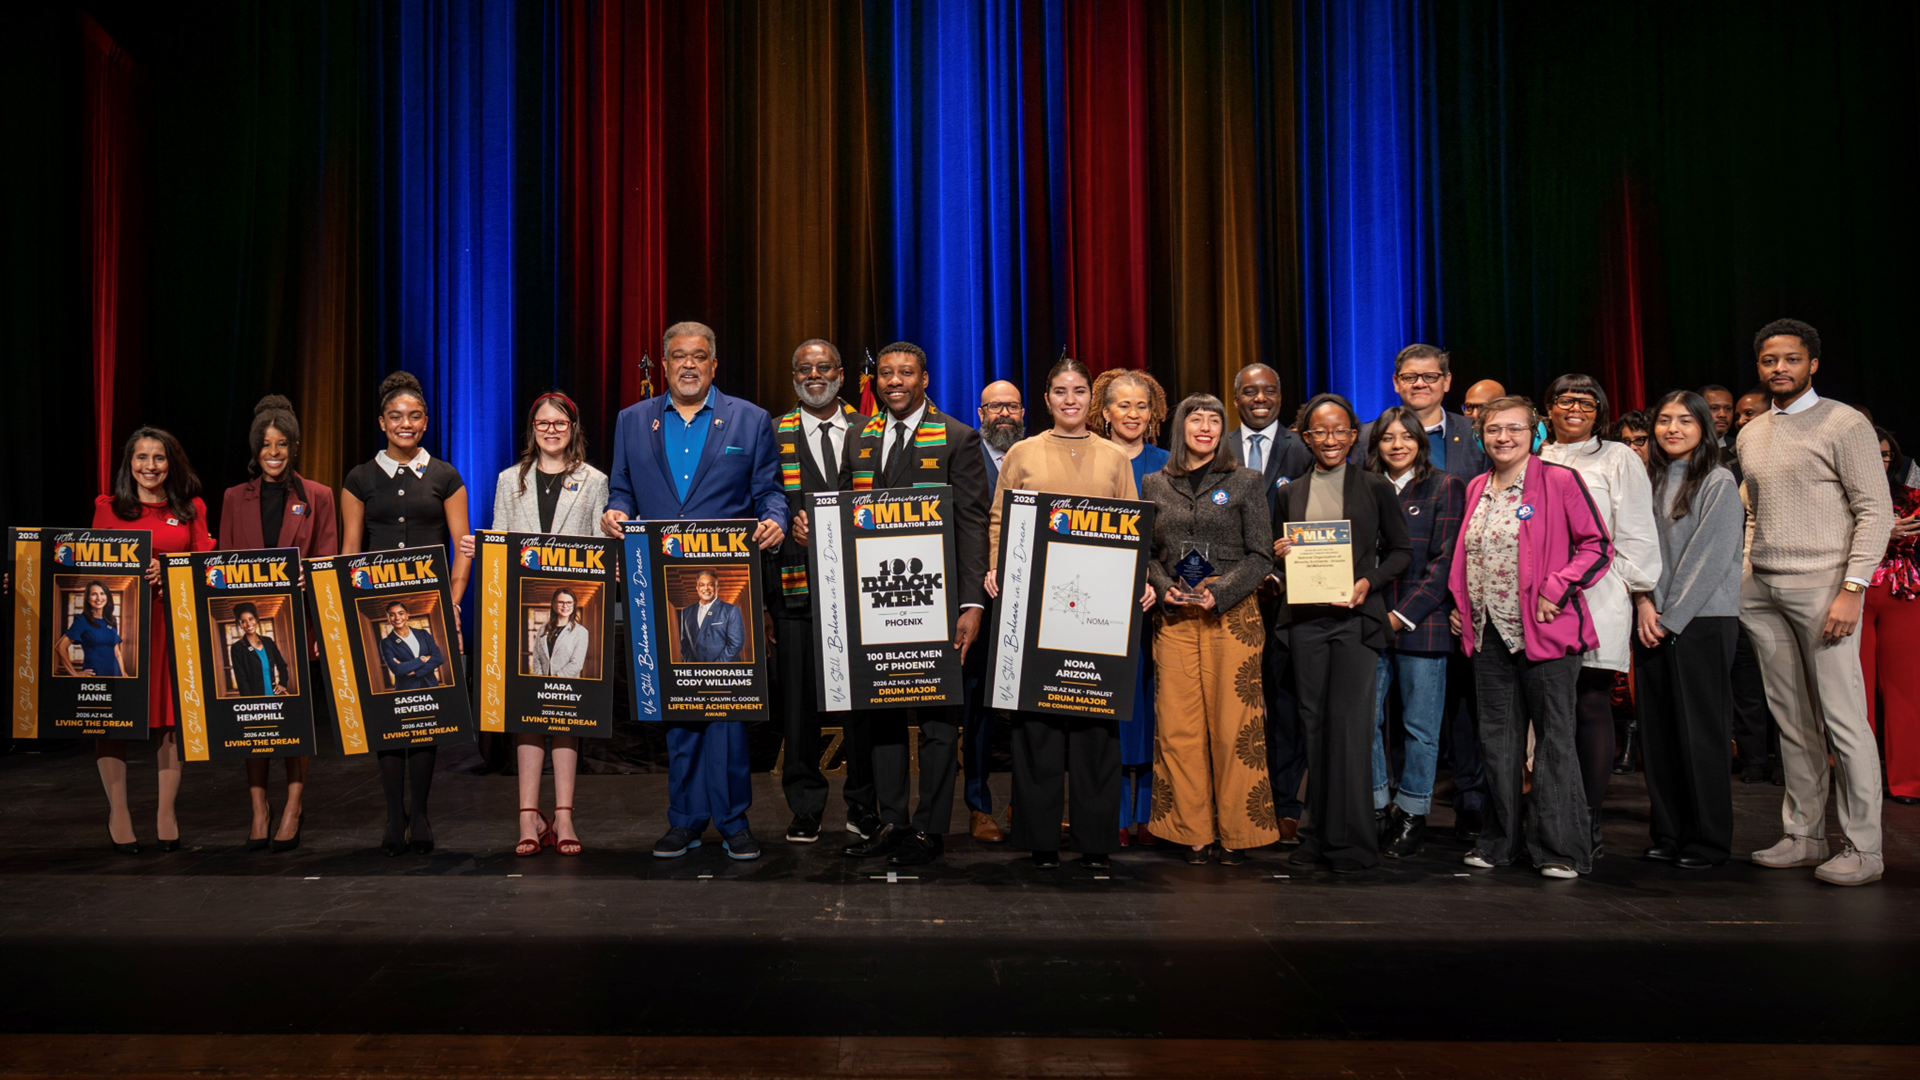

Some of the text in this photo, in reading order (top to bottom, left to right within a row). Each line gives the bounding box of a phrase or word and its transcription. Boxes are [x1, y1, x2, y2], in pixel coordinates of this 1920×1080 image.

[816, 497, 837, 505] 2026
[852, 492, 939, 506] 40th Anniversary
[1014, 495, 1035, 504] 2026
[875, 500, 942, 523] MLK
[1050, 498, 1140, 516] 40th Anniversary
[1071, 509, 1141, 535] MLK
[660, 523, 746, 535] 40th Anniversary
[1071, 530, 1121, 539] CELEBRATION
[1303, 530, 1337, 540] MLK
[54, 532, 139, 544] 40th Anniversary
[520, 537, 604, 551] 40th Anniversary
[683, 533, 749, 552] MLK
[76, 543, 140, 562] MLK
[541, 547, 605, 569] MLK
[204, 554, 286, 566] 40th Anniversary
[312, 561, 333, 569] 2026
[348, 554, 432, 568] 40th Anniversary
[226, 562, 289, 583] MLK
[371, 559, 437, 584] MLK
[879, 557, 923, 576] 100
[374, 580, 420, 589] CELEBRATION
[861, 573, 943, 593] BLACK
[871, 590, 934, 608] MEN
[822, 521, 846, 703] We Still Believe in the Dream
[999, 519, 1027, 701] We Still Believe in the Dream
[885, 618, 923, 627] PHOENIX
[633, 547, 657, 715] We Still Believe in the Dream
[485, 557, 502, 725] We Still Believe in the Dream
[867, 650, 942, 661] 100 BLACK MEN
[875, 661, 936, 671] OF PHOENIX
[1064, 659, 1095, 669] NOMA
[1056, 669, 1102, 681] ARIZONA
[81, 683, 107, 691] ROSE
[544, 683, 573, 691] MARA
[879, 686, 936, 695] DRUM MAJOR
[394, 694, 433, 704] SASCHA
[537, 692, 582, 701] NORTHEY
[1048, 694, 1107, 706] DRUM MAJOR
[233, 702, 283, 711] COURTNEY
[394, 703, 439, 714] REVERON
[1052, 703, 1089, 712] COMMUNITY
[237, 713, 284, 721] HEMPHILL
[383, 731, 410, 739] LIVING
[429, 726, 458, 734] DREAM
